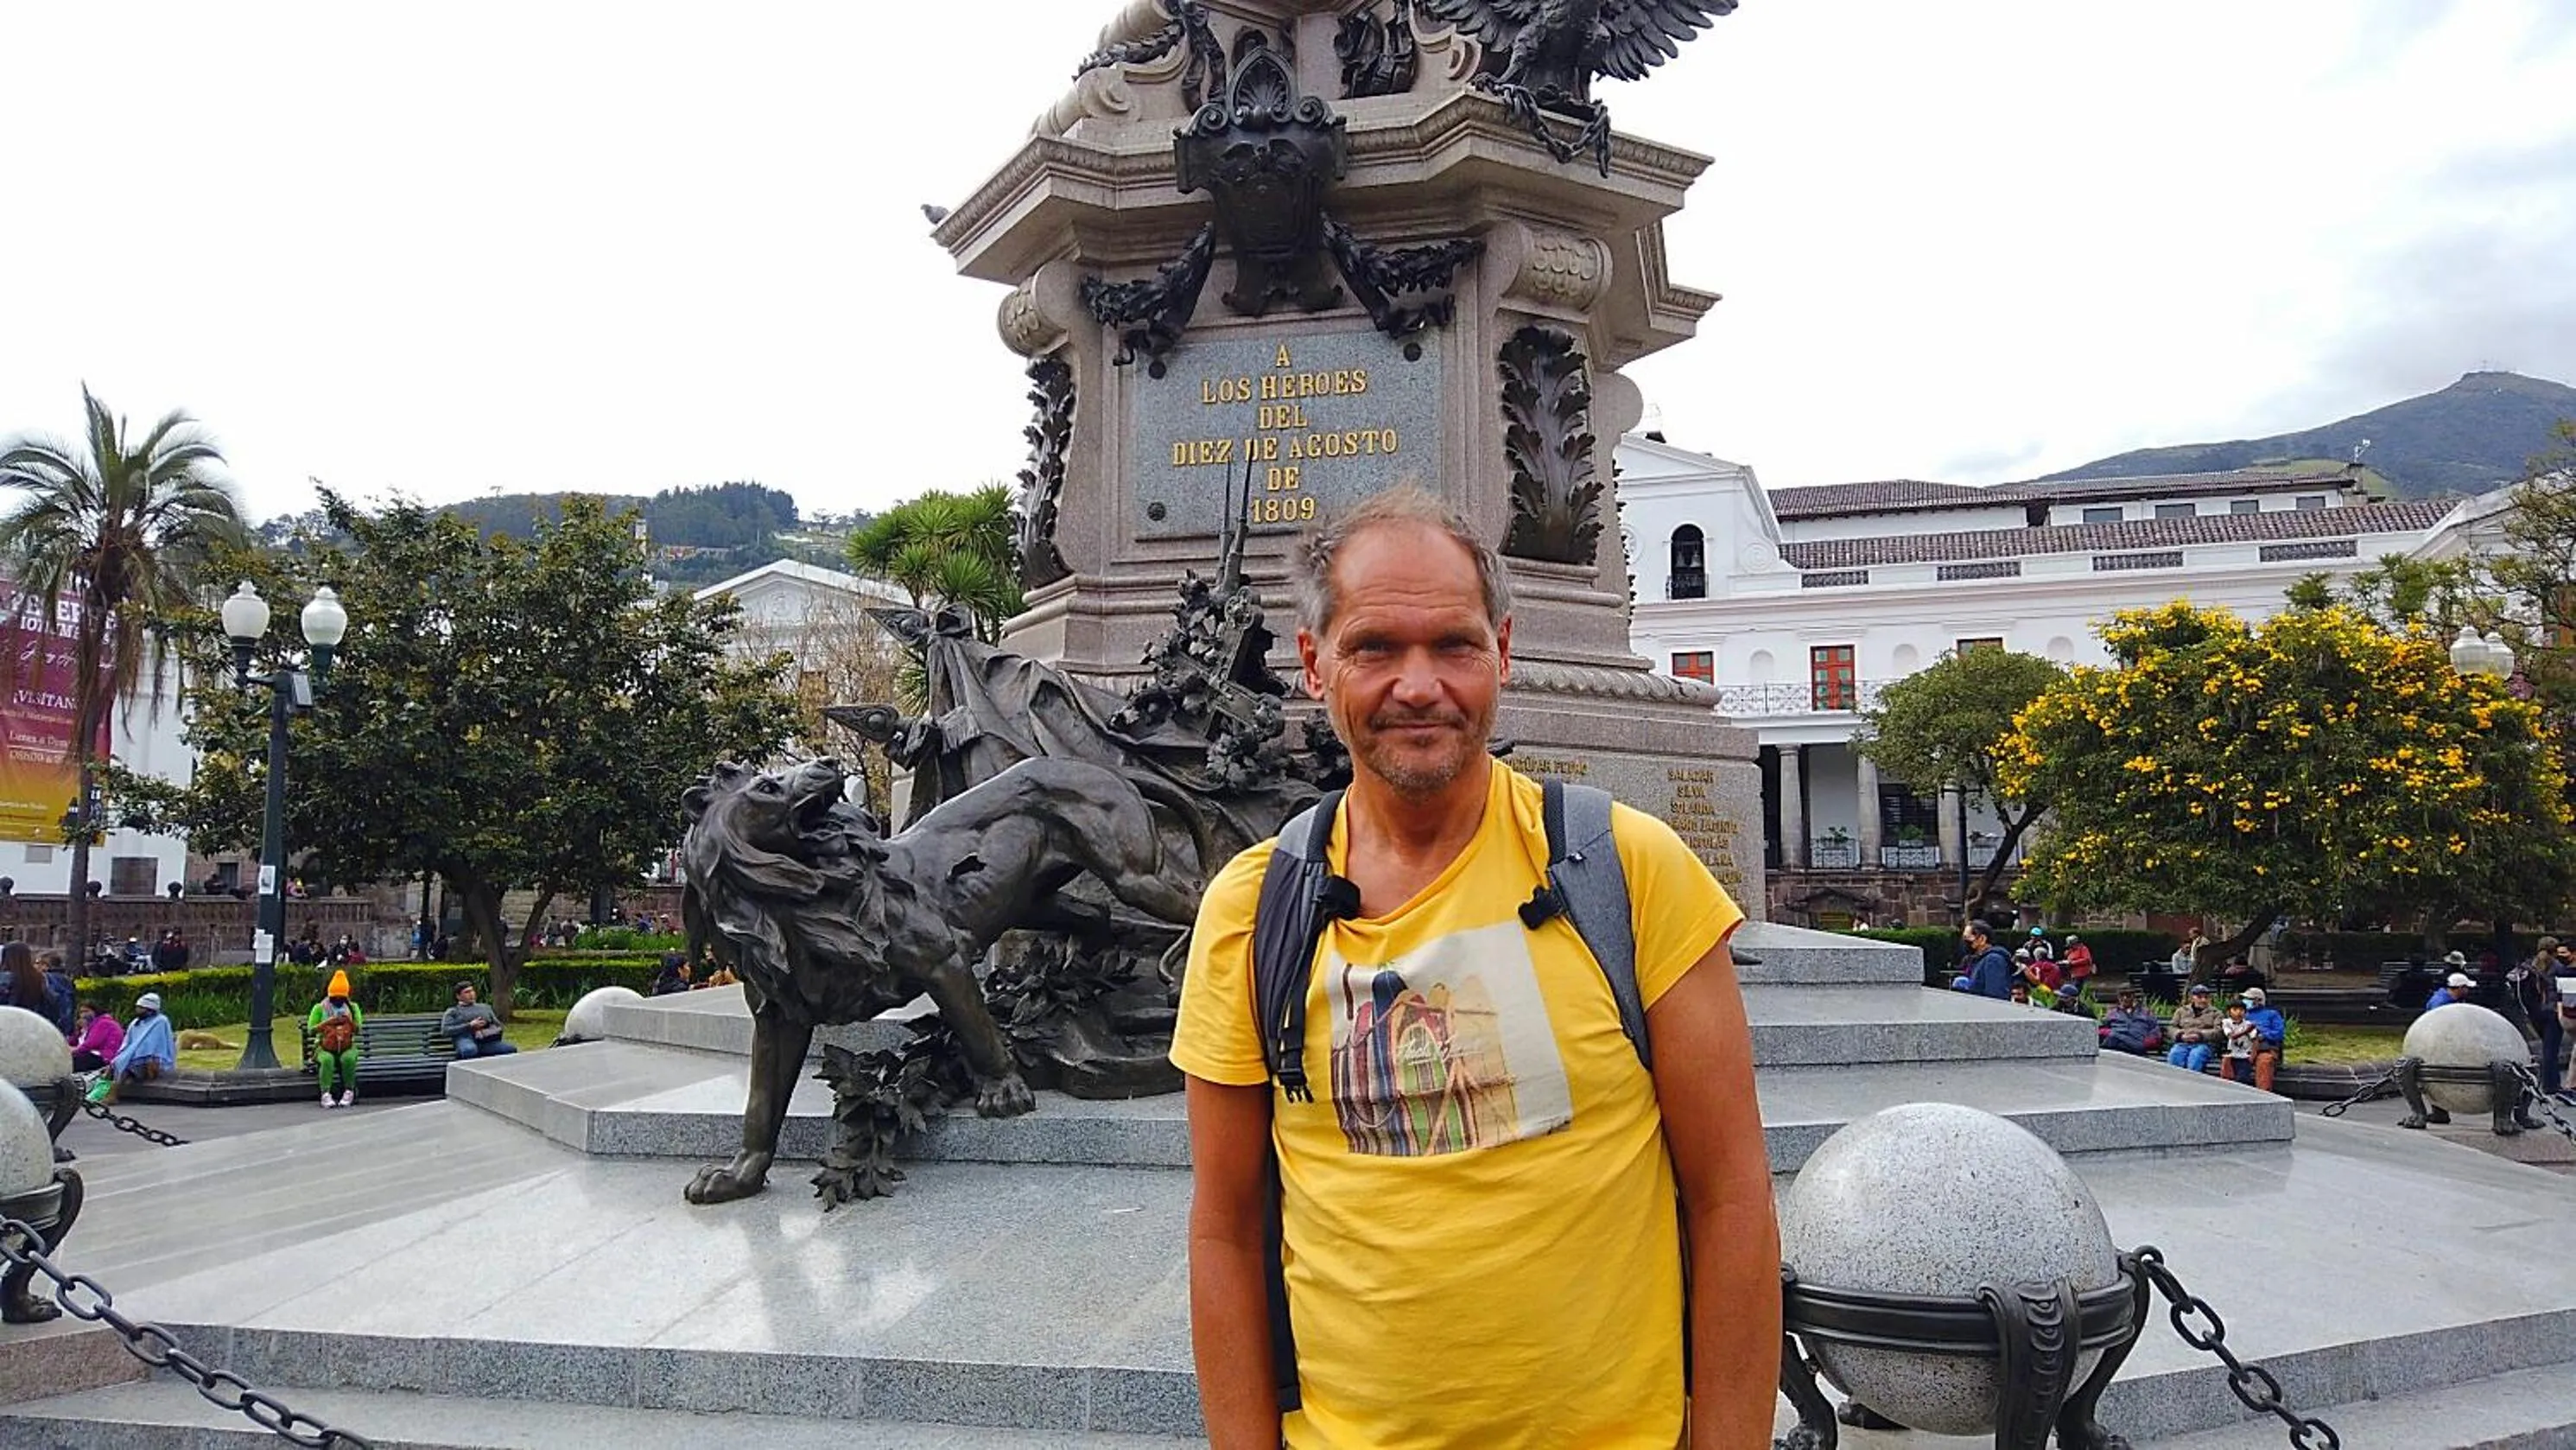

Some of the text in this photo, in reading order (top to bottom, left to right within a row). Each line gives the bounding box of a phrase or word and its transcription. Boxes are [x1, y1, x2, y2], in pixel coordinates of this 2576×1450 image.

[1276, 344, 1291, 367] A
[1202, 370, 1368, 404] LOS HEROES
[1259, 405, 1308, 429] DEL
[1172, 429, 1398, 467] DIEZ DE AGOSTO
[1266, 467, 1299, 492] DE
[1251, 497, 1316, 523] 1809
